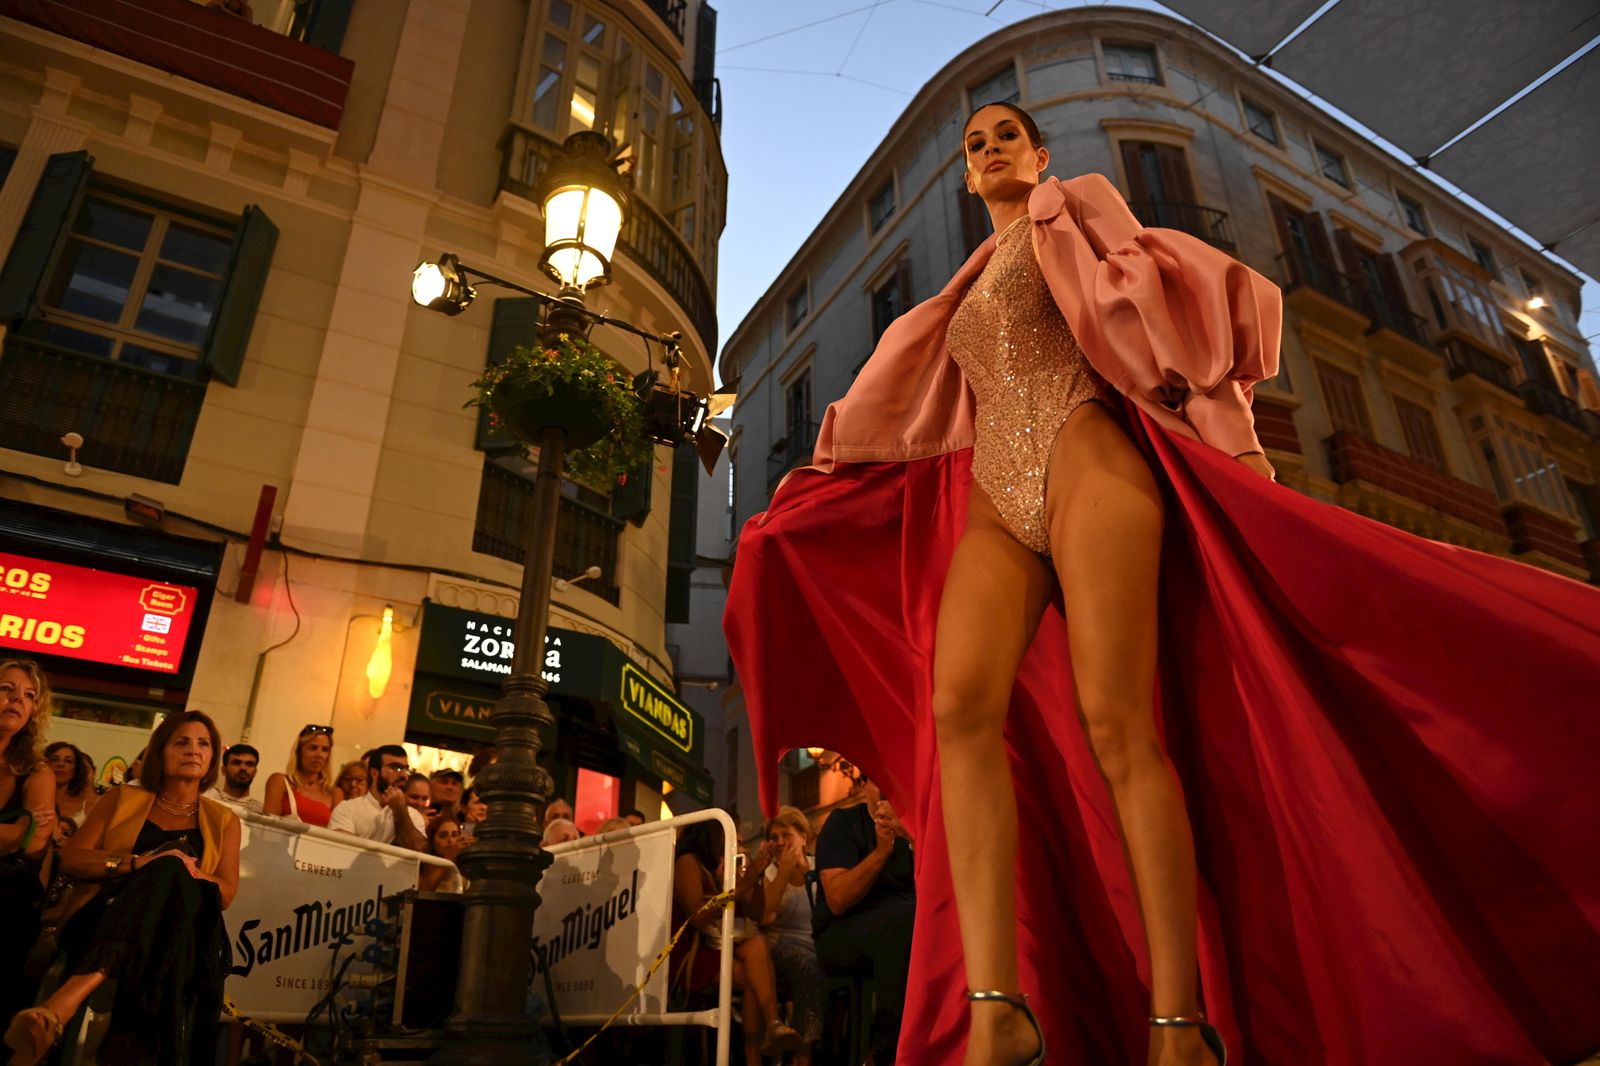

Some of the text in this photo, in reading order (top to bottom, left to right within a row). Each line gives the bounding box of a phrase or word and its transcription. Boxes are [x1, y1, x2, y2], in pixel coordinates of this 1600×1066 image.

[0, 565, 52, 593] OS
[135, 644, 169, 656] Stamps
[463, 633, 562, 668] ZORa
[141, 657, 174, 670] Tickets
[461, 657, 512, 675] SALAMAN
[439, 697, 491, 721] VIAN
[629, 677, 688, 740] VIANDAS
[294, 859, 343, 879] CERVEZAS
[275, 975, 330, 991] SINCE 189
